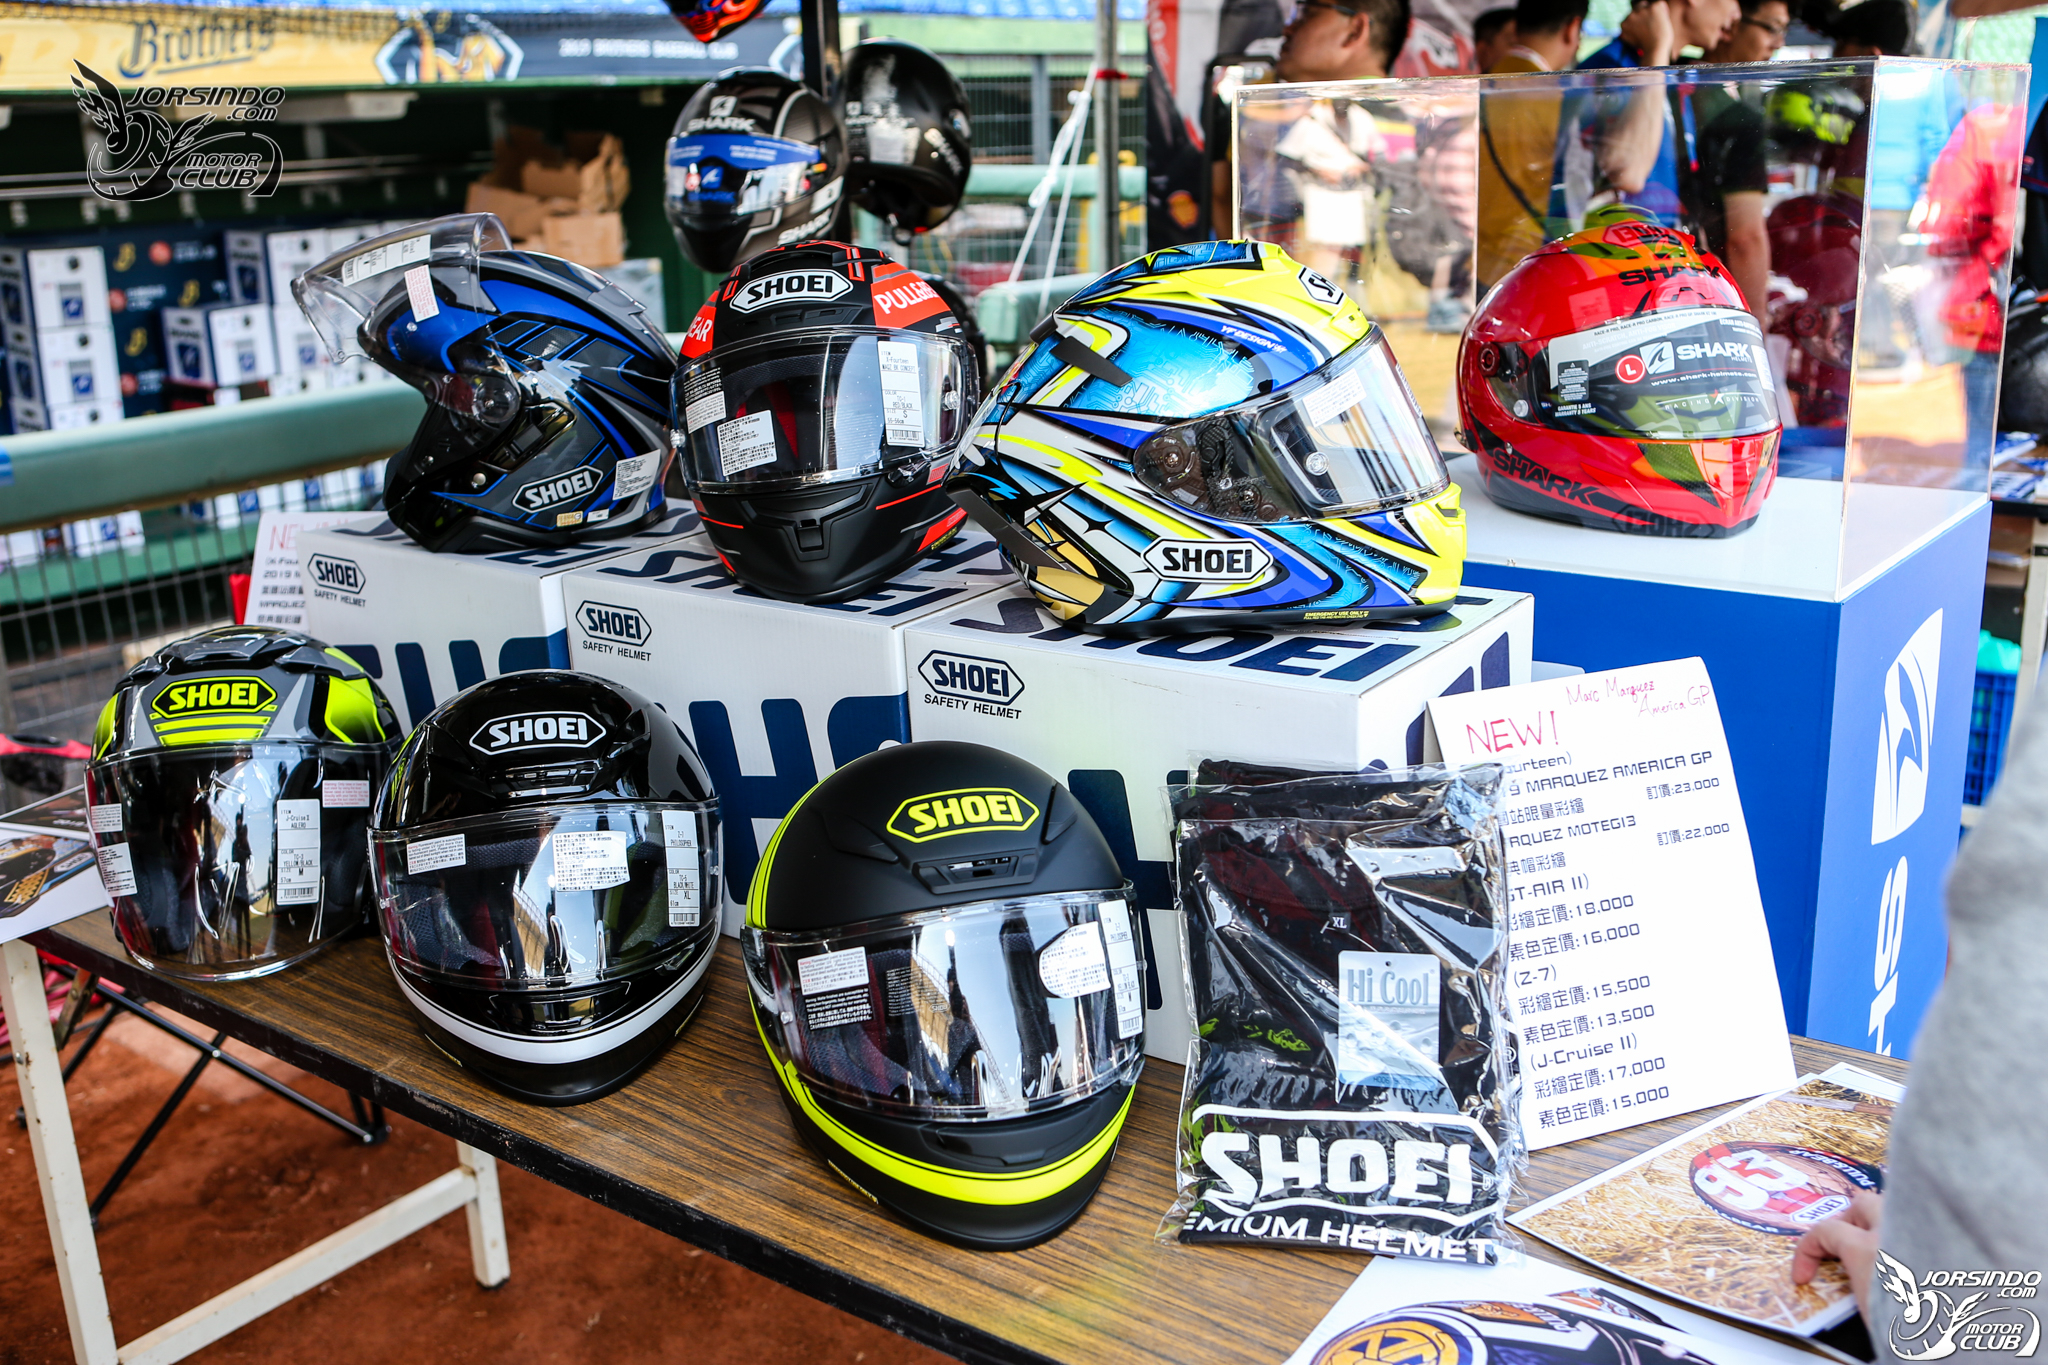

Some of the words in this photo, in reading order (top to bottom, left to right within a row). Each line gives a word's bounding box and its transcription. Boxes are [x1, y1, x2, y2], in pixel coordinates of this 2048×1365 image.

[688, 116, 756, 132] SHARK
[1619, 262, 1721, 287] SHARK
[747, 274, 834, 305] SHOEI
[1234, 330, 1276, 349] DESIGN
[1676, 341, 1750, 361] SHARK
[1625, 363, 1637, 376] L
[525, 471, 594, 509] SHOEI
[1493, 447, 1600, 506] SHARK
[269, 523, 300, 552] NE
[316, 560, 358, 588] SHOEI
[1162, 547, 1252, 573] SHOEI
[314, 589, 338, 601] SAFETY
[340, 595, 366, 608] HELMET
[586, 607, 641, 640] SHOEI
[582, 640, 613, 655] SAFETY
[617, 647, 651, 662] HELMET
[932, 658, 1010, 698] SHOEI
[1566, 684, 1600, 705] Marc
[1605, 677, 1655, 703] Marquez
[168, 683, 258, 711] SHOEI
[924, 693, 969, 711] SAFETY
[973, 703, 1022, 720] HELMET
[1638, 694, 1686, 718] America
[1687, 684, 1711, 706] GP
[489, 717, 588, 748] SHOEI
[1466, 710, 1559, 754] NEW!
[1526, 768, 1608, 793] MARQUEZ
[1613, 755, 1686, 778] AMERICA
[1691, 751, 1713, 766] GP
[908, 795, 1024, 834] SHOEI
[684, 890, 691, 900] XL
[1332, 916, 1347, 928] XL
[1347, 967, 1373, 1003] Hi
[1380, 970, 1429, 1006] Cool
[1513, 965, 1557, 988] (Z-7)
[1530, 1040, 1614, 1071] (J-Cruise
[1201, 1131, 1473, 1206] SHOEI
[1694, 1148, 1810, 1211] 93
[1799, 1199, 1842, 1221] SHOEI
[1320, 1219, 1493, 1264] HELMET
